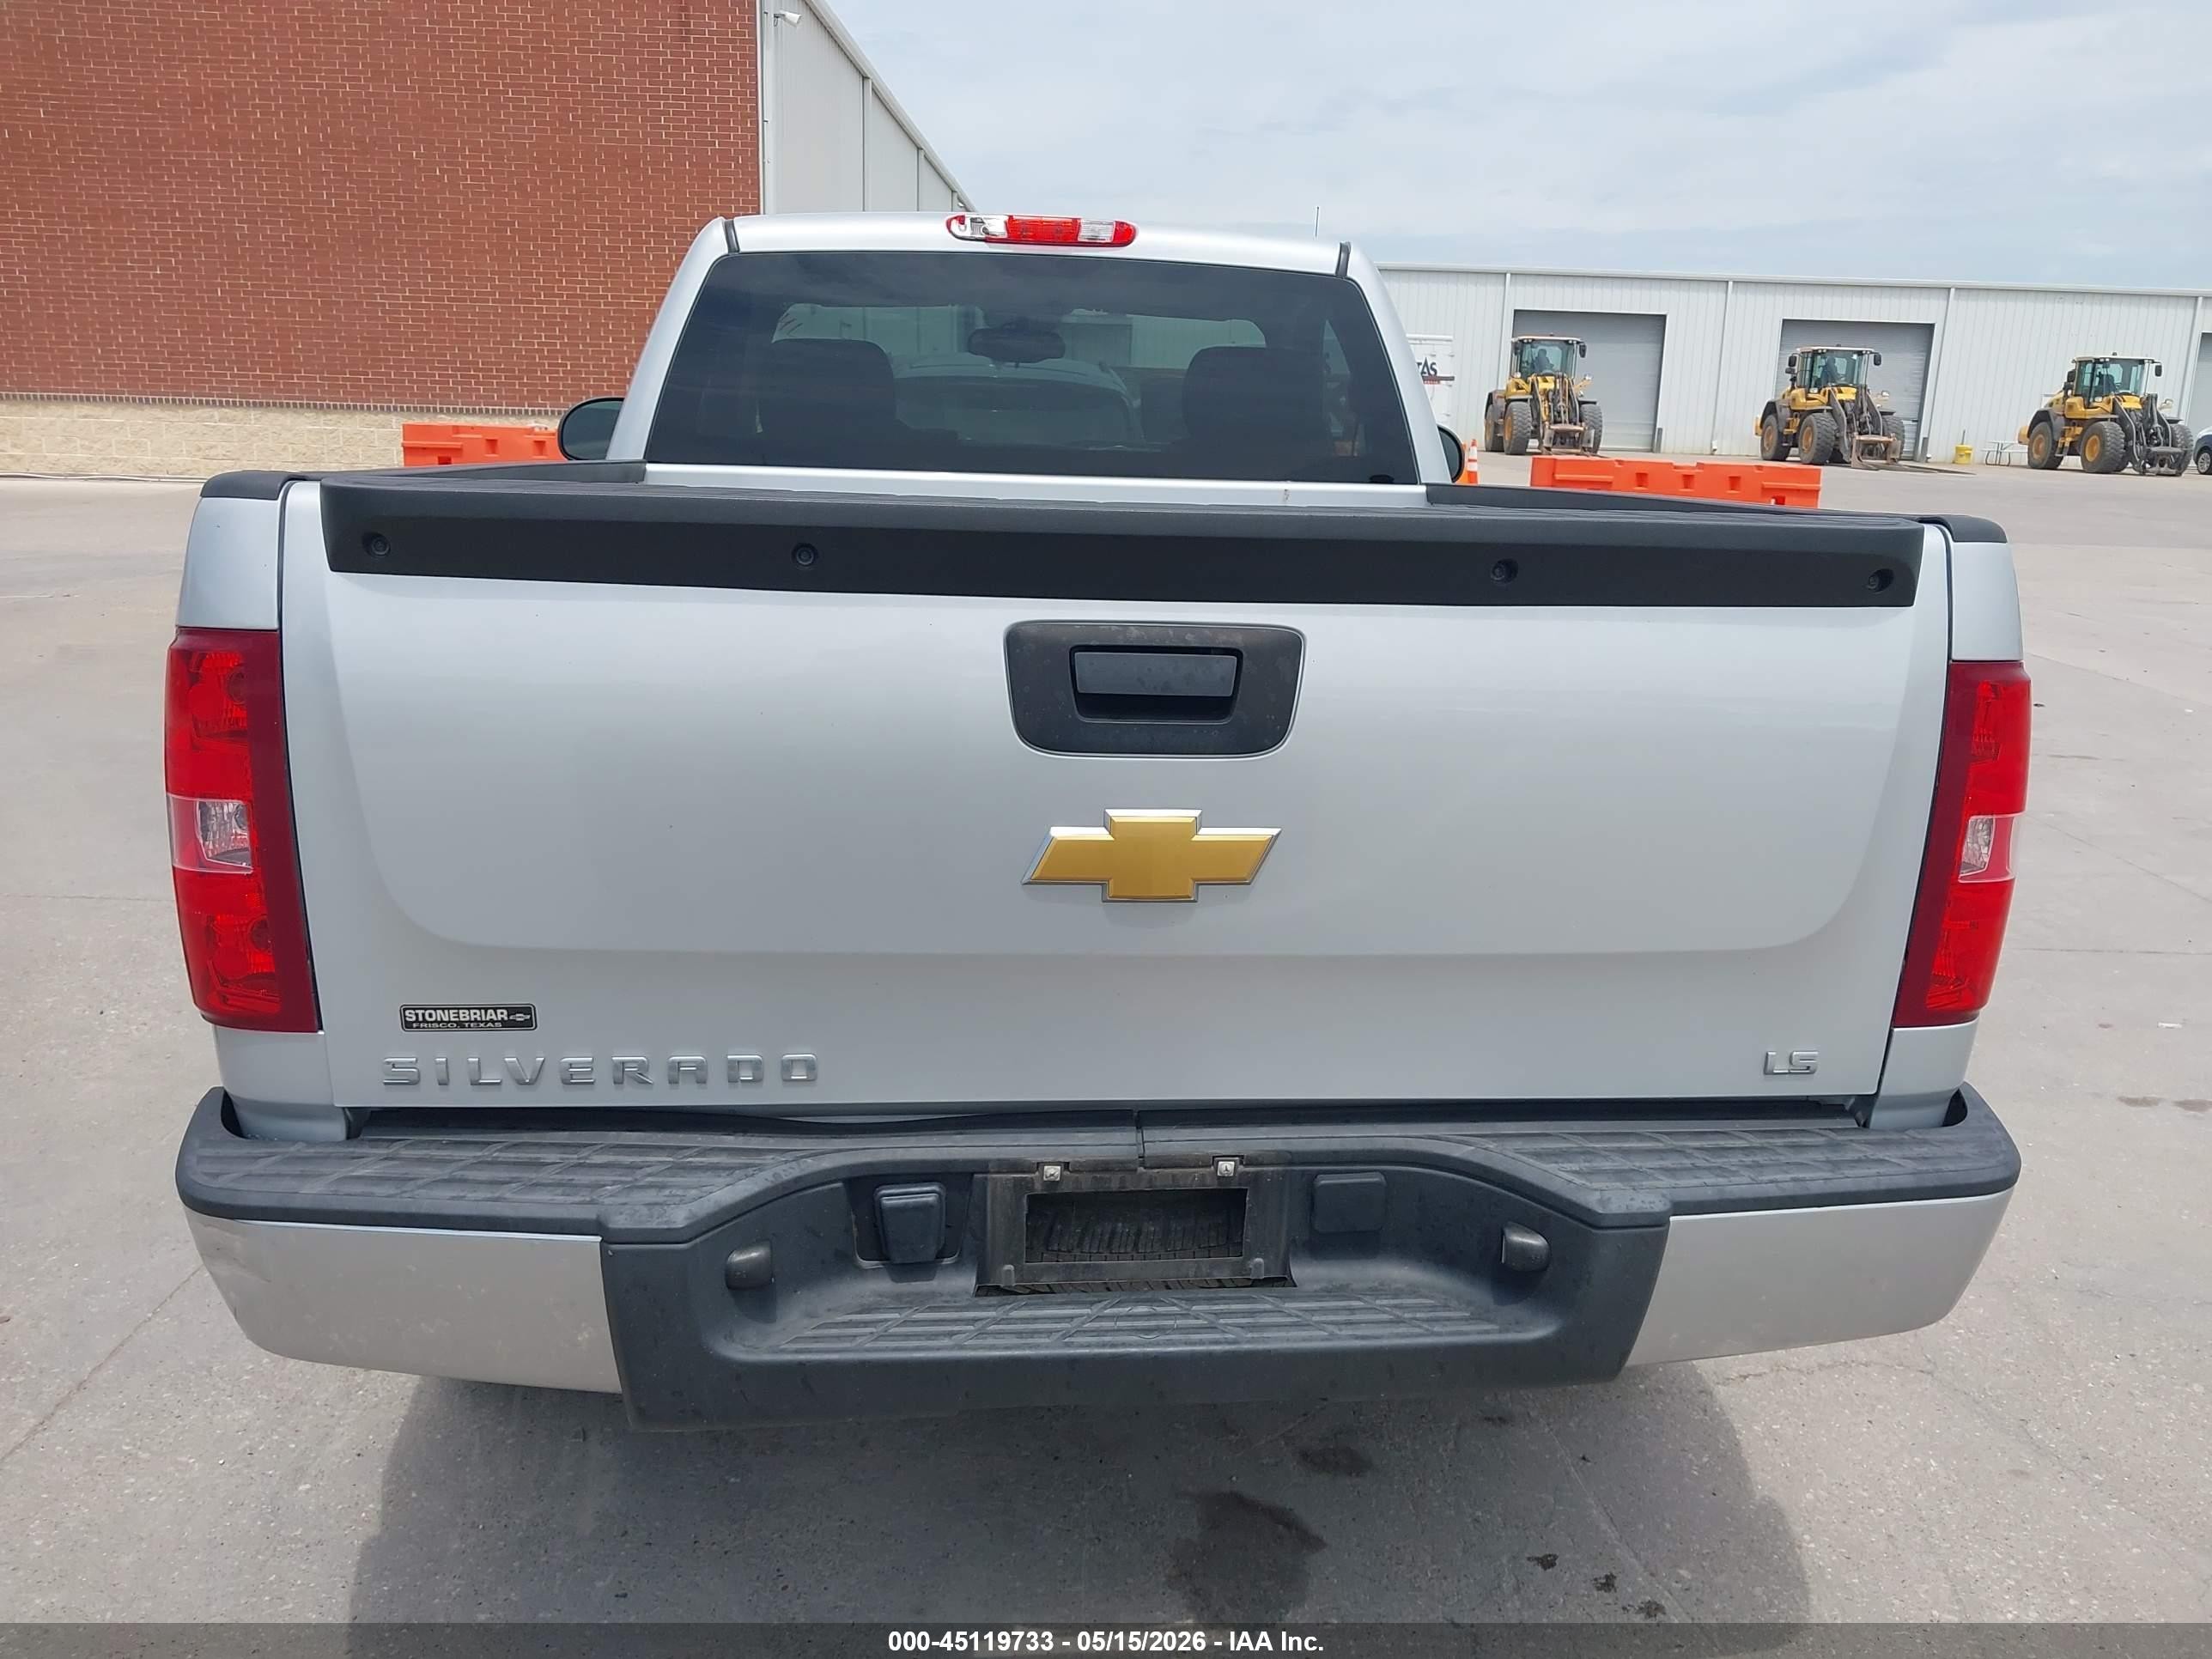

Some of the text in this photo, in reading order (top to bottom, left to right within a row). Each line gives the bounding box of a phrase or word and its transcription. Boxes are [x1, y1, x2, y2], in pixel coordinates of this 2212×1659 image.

[404, 1009, 508, 1022] STONEBRIAR
[382, 1054, 817, 1085] SILVERADO
[1763, 1050, 1819, 1075] LS
